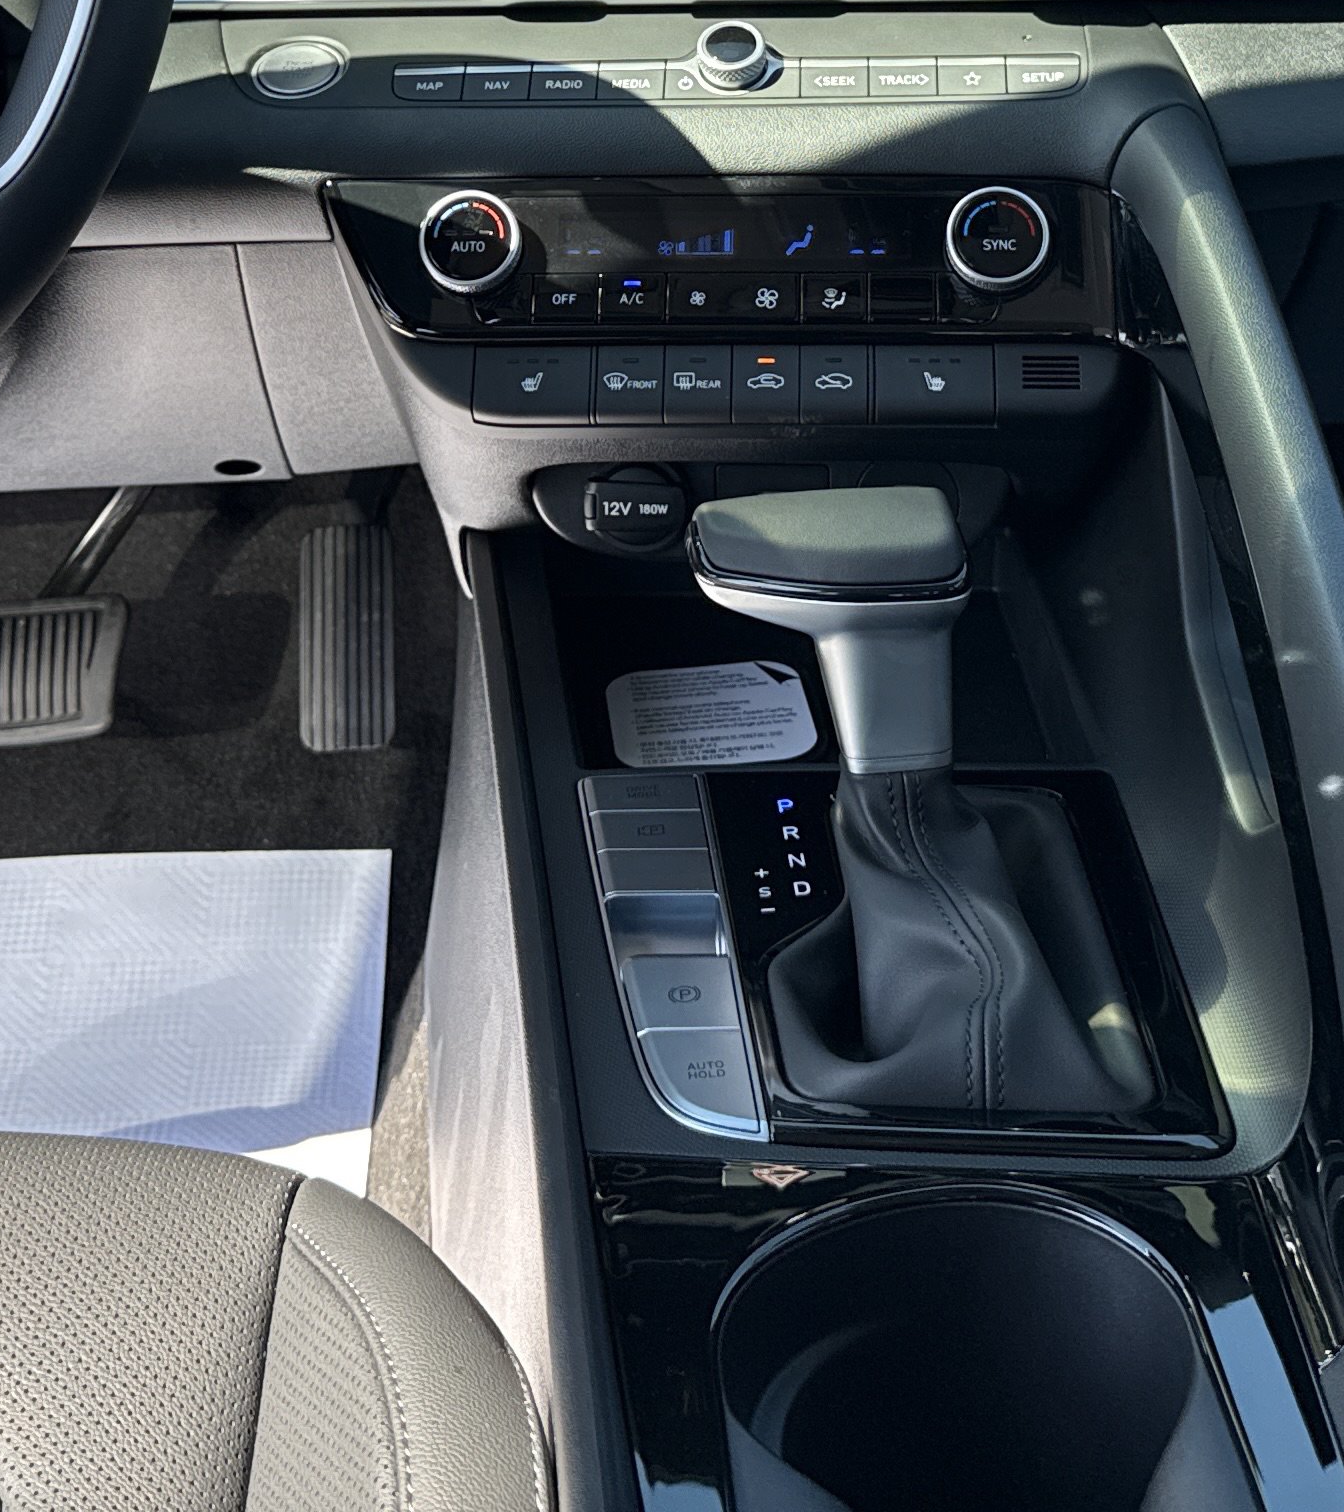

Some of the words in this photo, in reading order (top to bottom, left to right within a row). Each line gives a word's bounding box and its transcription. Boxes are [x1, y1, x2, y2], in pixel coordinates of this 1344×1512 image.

[545, 78, 583, 90] RADIO
[611, 78, 651, 90] MEDIA
[1021, 71, 1065, 85] SETUP
[416, 80, 444, 92] MAP
[484, 79, 511, 91] NAV
[450, 240, 486, 254] AUTO
[982, 238, 1017, 252] SYNC
[552, 293, 577, 306] OFF
[619, 292, 644, 306] A/C
[626, 379, 658, 389] FRONT
[696, 379, 722, 389] REAR
[602, 501, 632, 517] 12V
[638, 503, 668, 515] 180W
[776, 798, 794, 814] P
[782, 825, 801, 840] R
[787, 852, 807, 868] N
[758, 886, 772, 898] S
[793, 881, 811, 897] D
[687, 1060, 725, 1071] AUTO
[687, 1068, 726, 1080] HOLD
